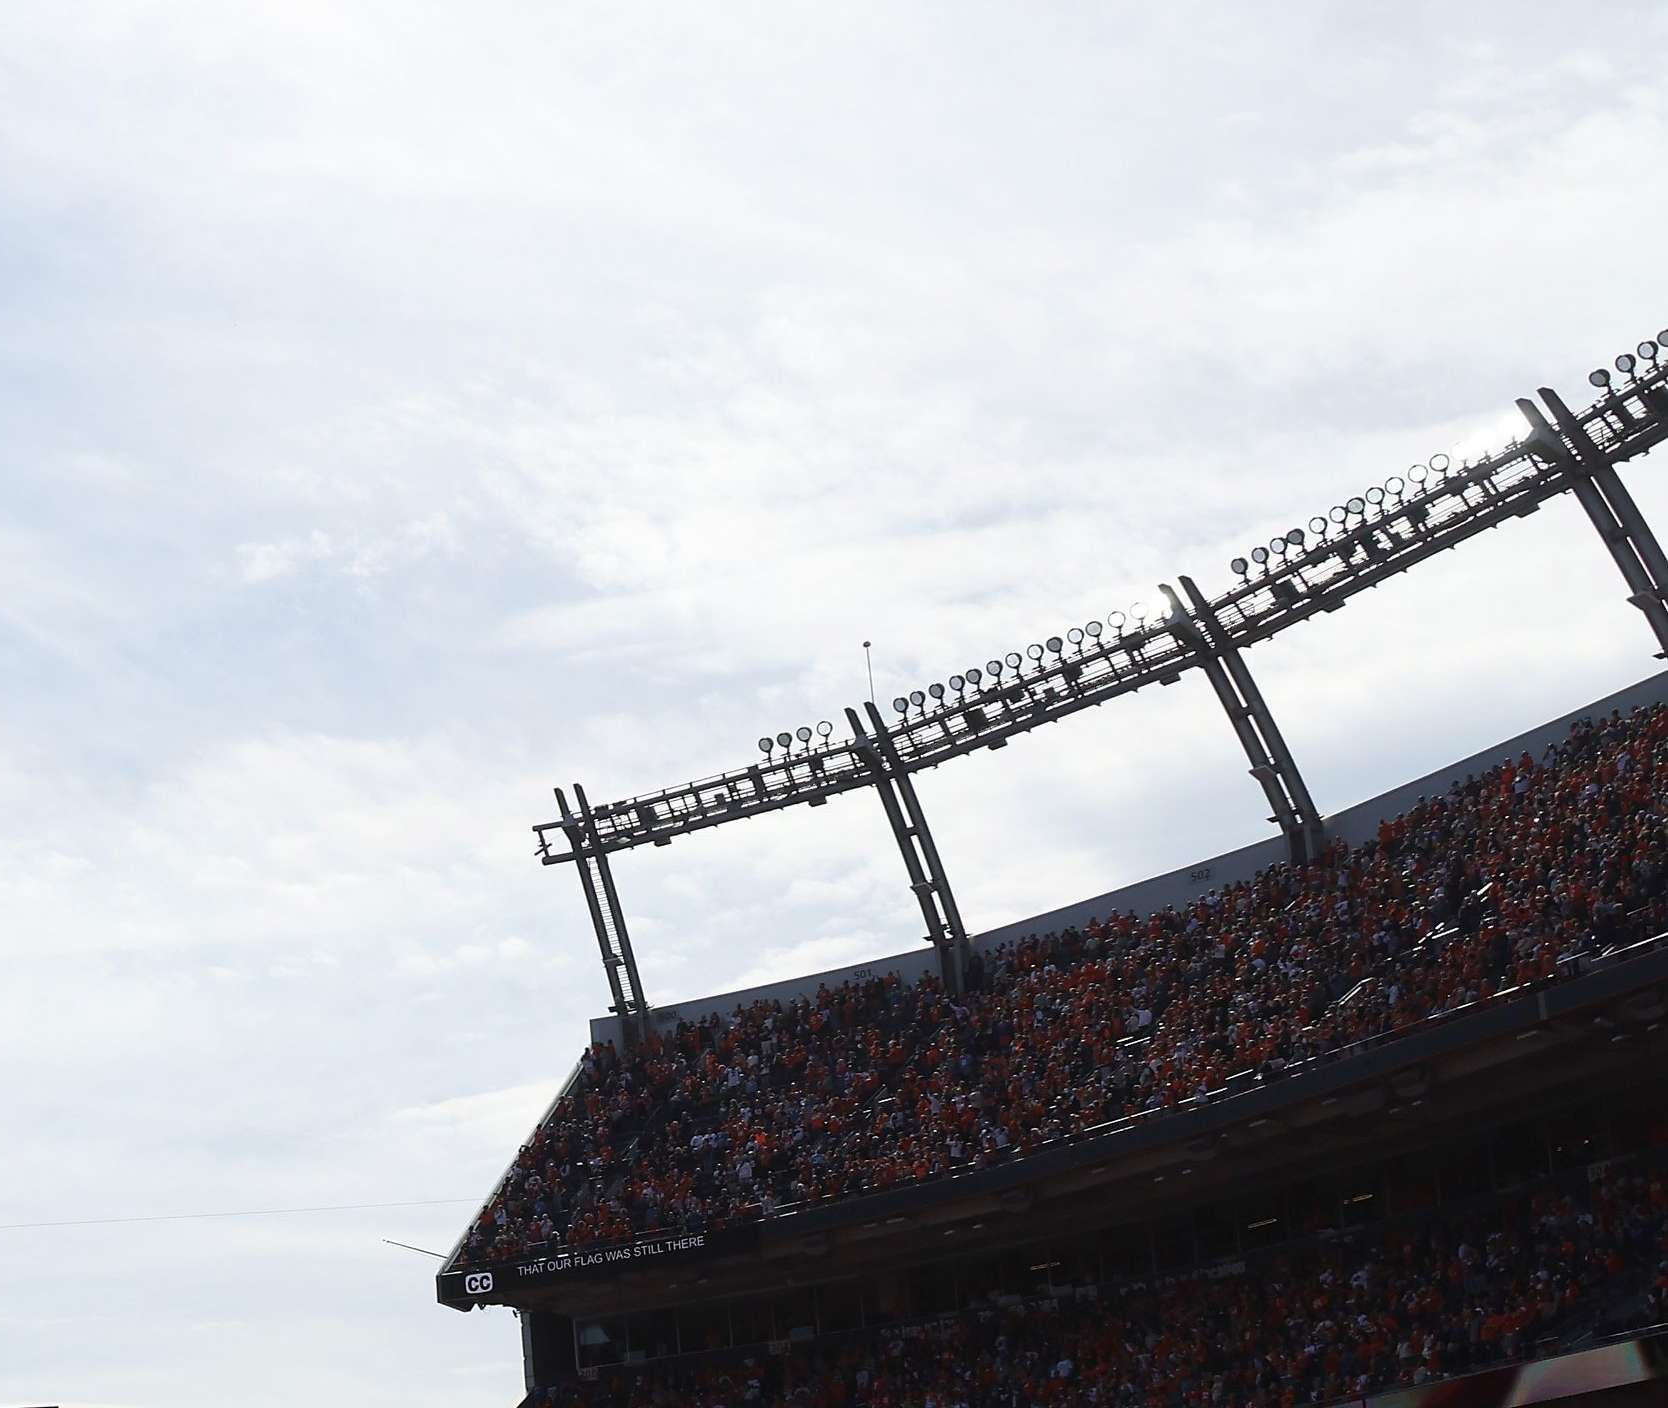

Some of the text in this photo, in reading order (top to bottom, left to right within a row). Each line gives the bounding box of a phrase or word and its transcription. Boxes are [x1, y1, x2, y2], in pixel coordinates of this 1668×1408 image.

[854, 968, 872, 980] 501
[517, 1235, 705, 1277] THAT OUR FLAG WAS STILL THERE
[466, 1275, 492, 1292] CC
